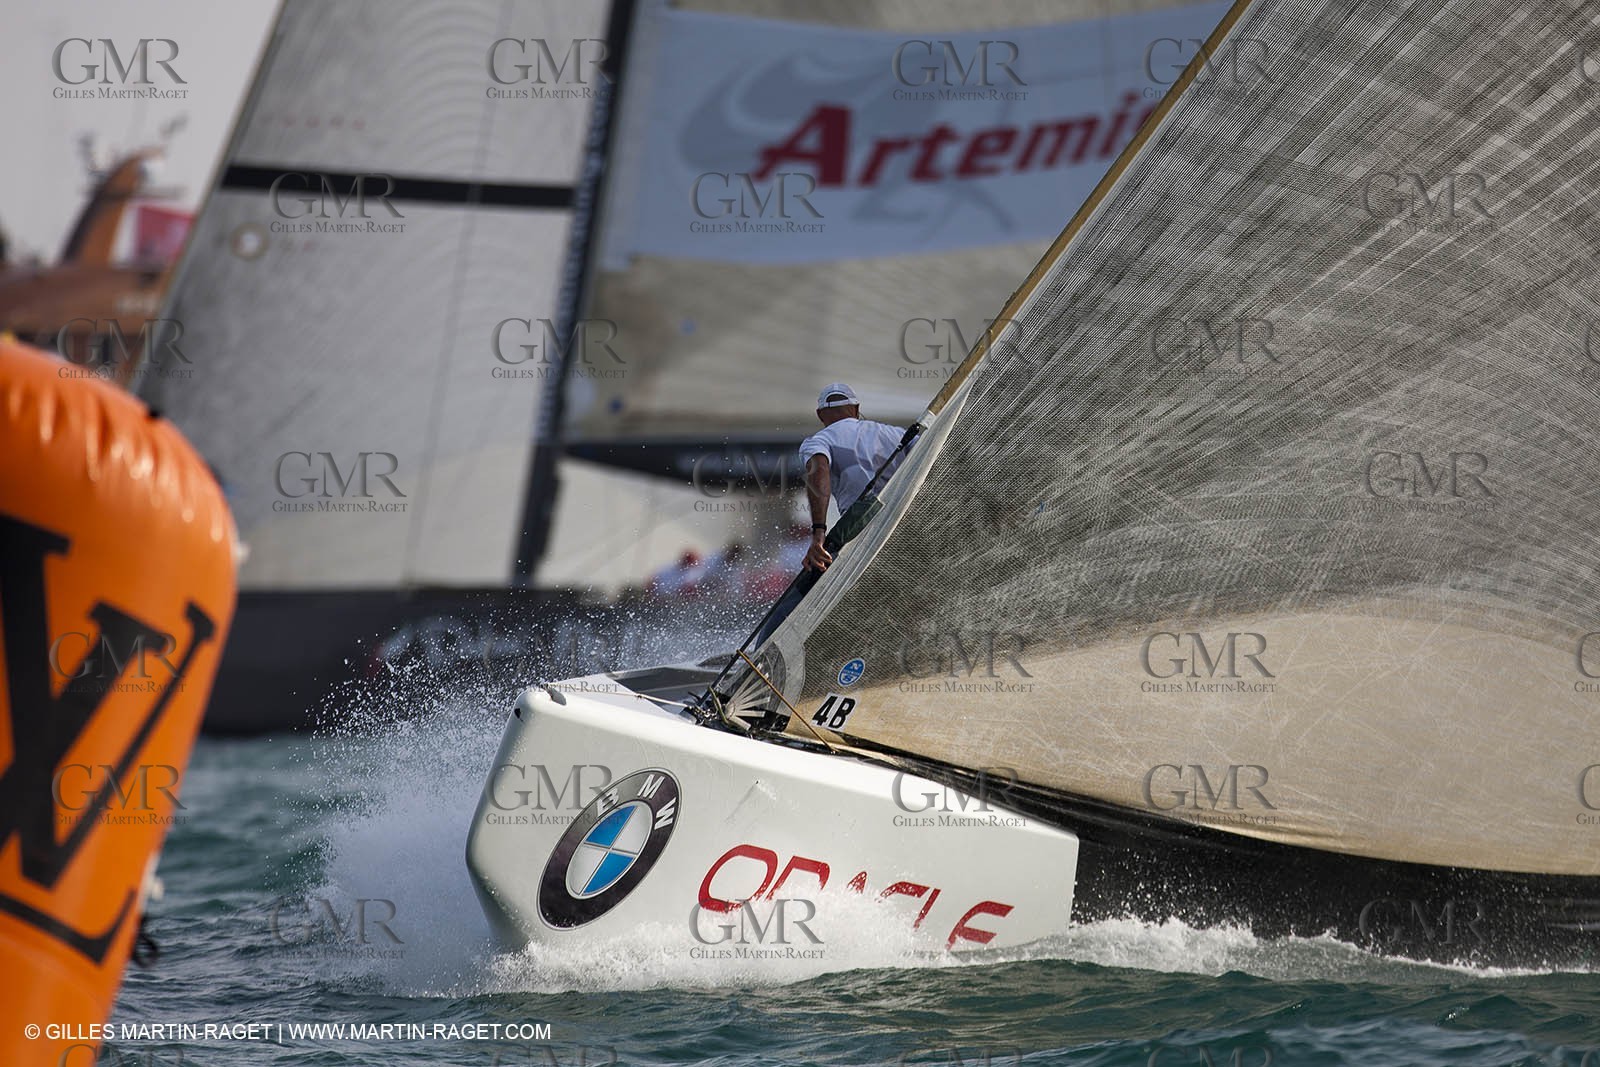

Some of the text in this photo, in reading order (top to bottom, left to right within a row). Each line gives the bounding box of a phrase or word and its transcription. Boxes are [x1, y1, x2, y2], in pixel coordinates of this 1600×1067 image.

[753, 92, 1161, 188] Artemi
[812, 696, 856, 729] 4B
[597, 774, 677, 830] BMW
[698, 844, 1015, 949] OLE
